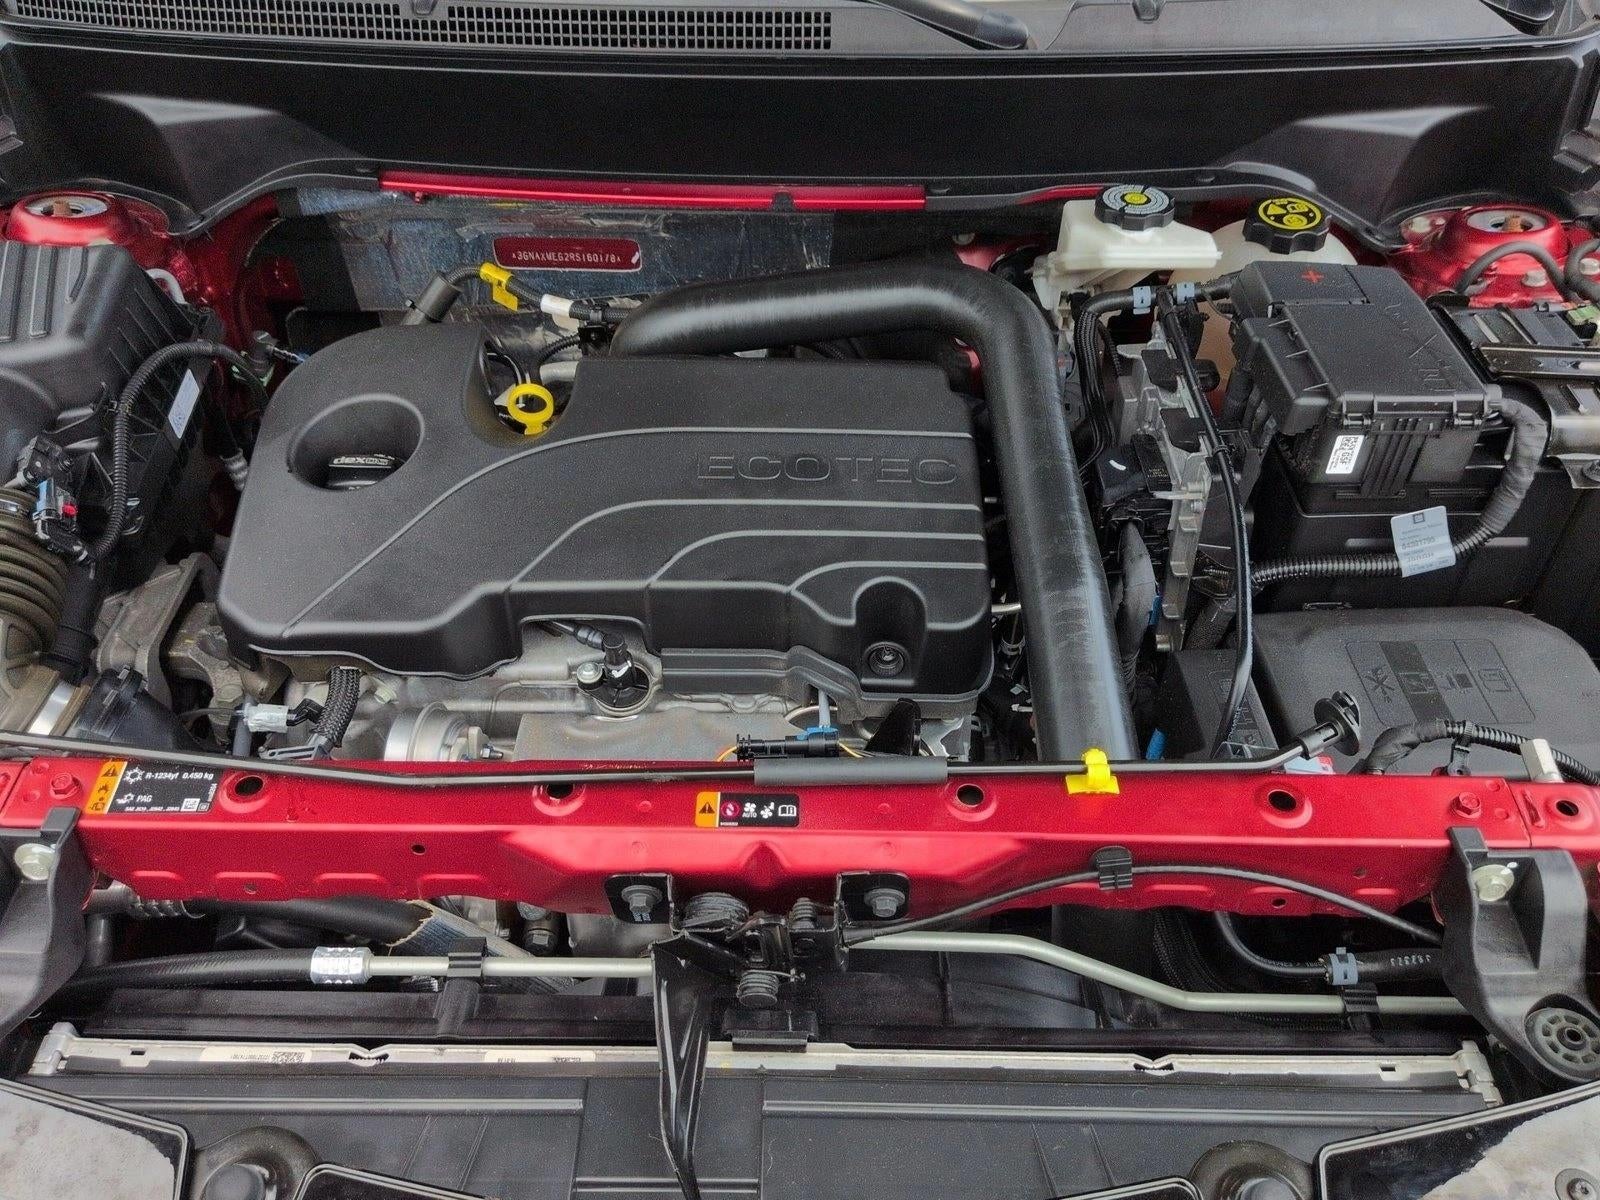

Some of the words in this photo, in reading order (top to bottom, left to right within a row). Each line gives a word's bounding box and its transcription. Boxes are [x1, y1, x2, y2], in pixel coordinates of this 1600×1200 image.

[697, 455, 957, 485] ECOTEC
[145, 772, 178, 781] R-1234yf
[182, 772, 202, 780] 0.450
[204, 772, 214, 781] kg
[136, 795, 153, 803] PAG
